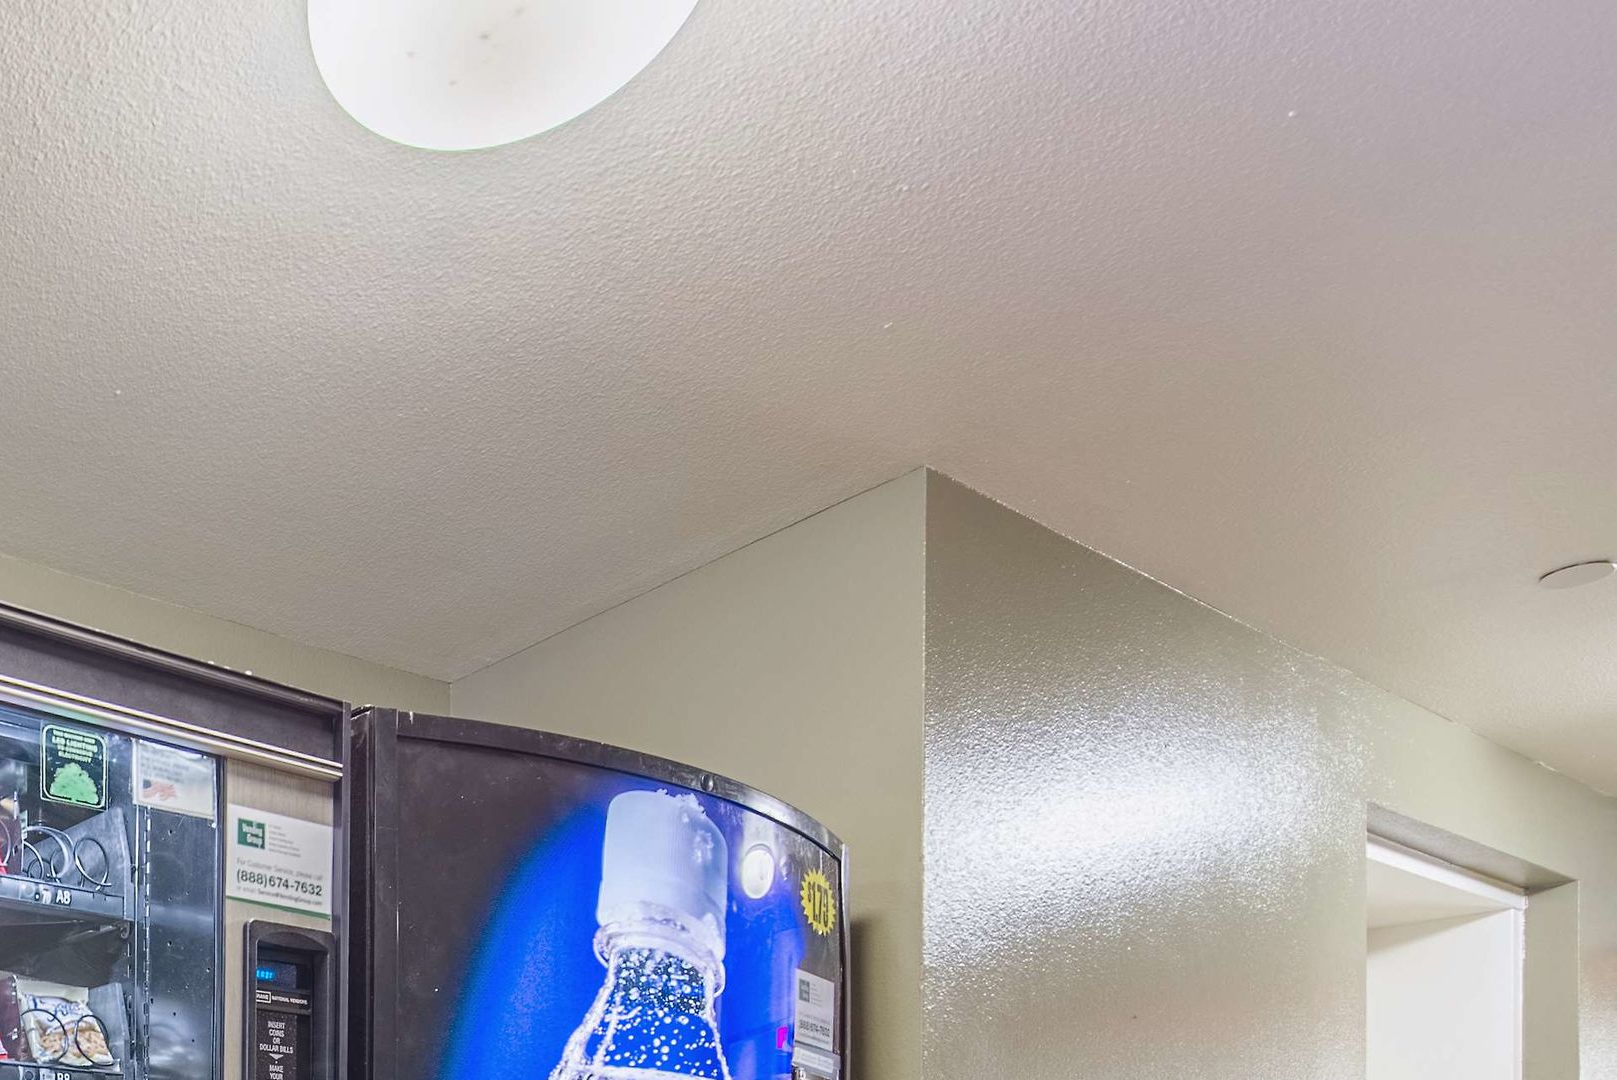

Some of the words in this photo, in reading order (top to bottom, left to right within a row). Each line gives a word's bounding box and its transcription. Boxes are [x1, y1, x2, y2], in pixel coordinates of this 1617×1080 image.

[236, 868, 323, 897] (888)674-7632
[56, 892, 71, 905] A8
[268, 1021, 285, 1029] INSERT
[269, 1029, 284, 1037] COINS
[259, 1044, 279, 1052] DOLLAR
[280, 1045, 293, 1054] BILLS
[269, 1064, 283, 1073] MAKE
[270, 1072, 283, 1080] YOUR
